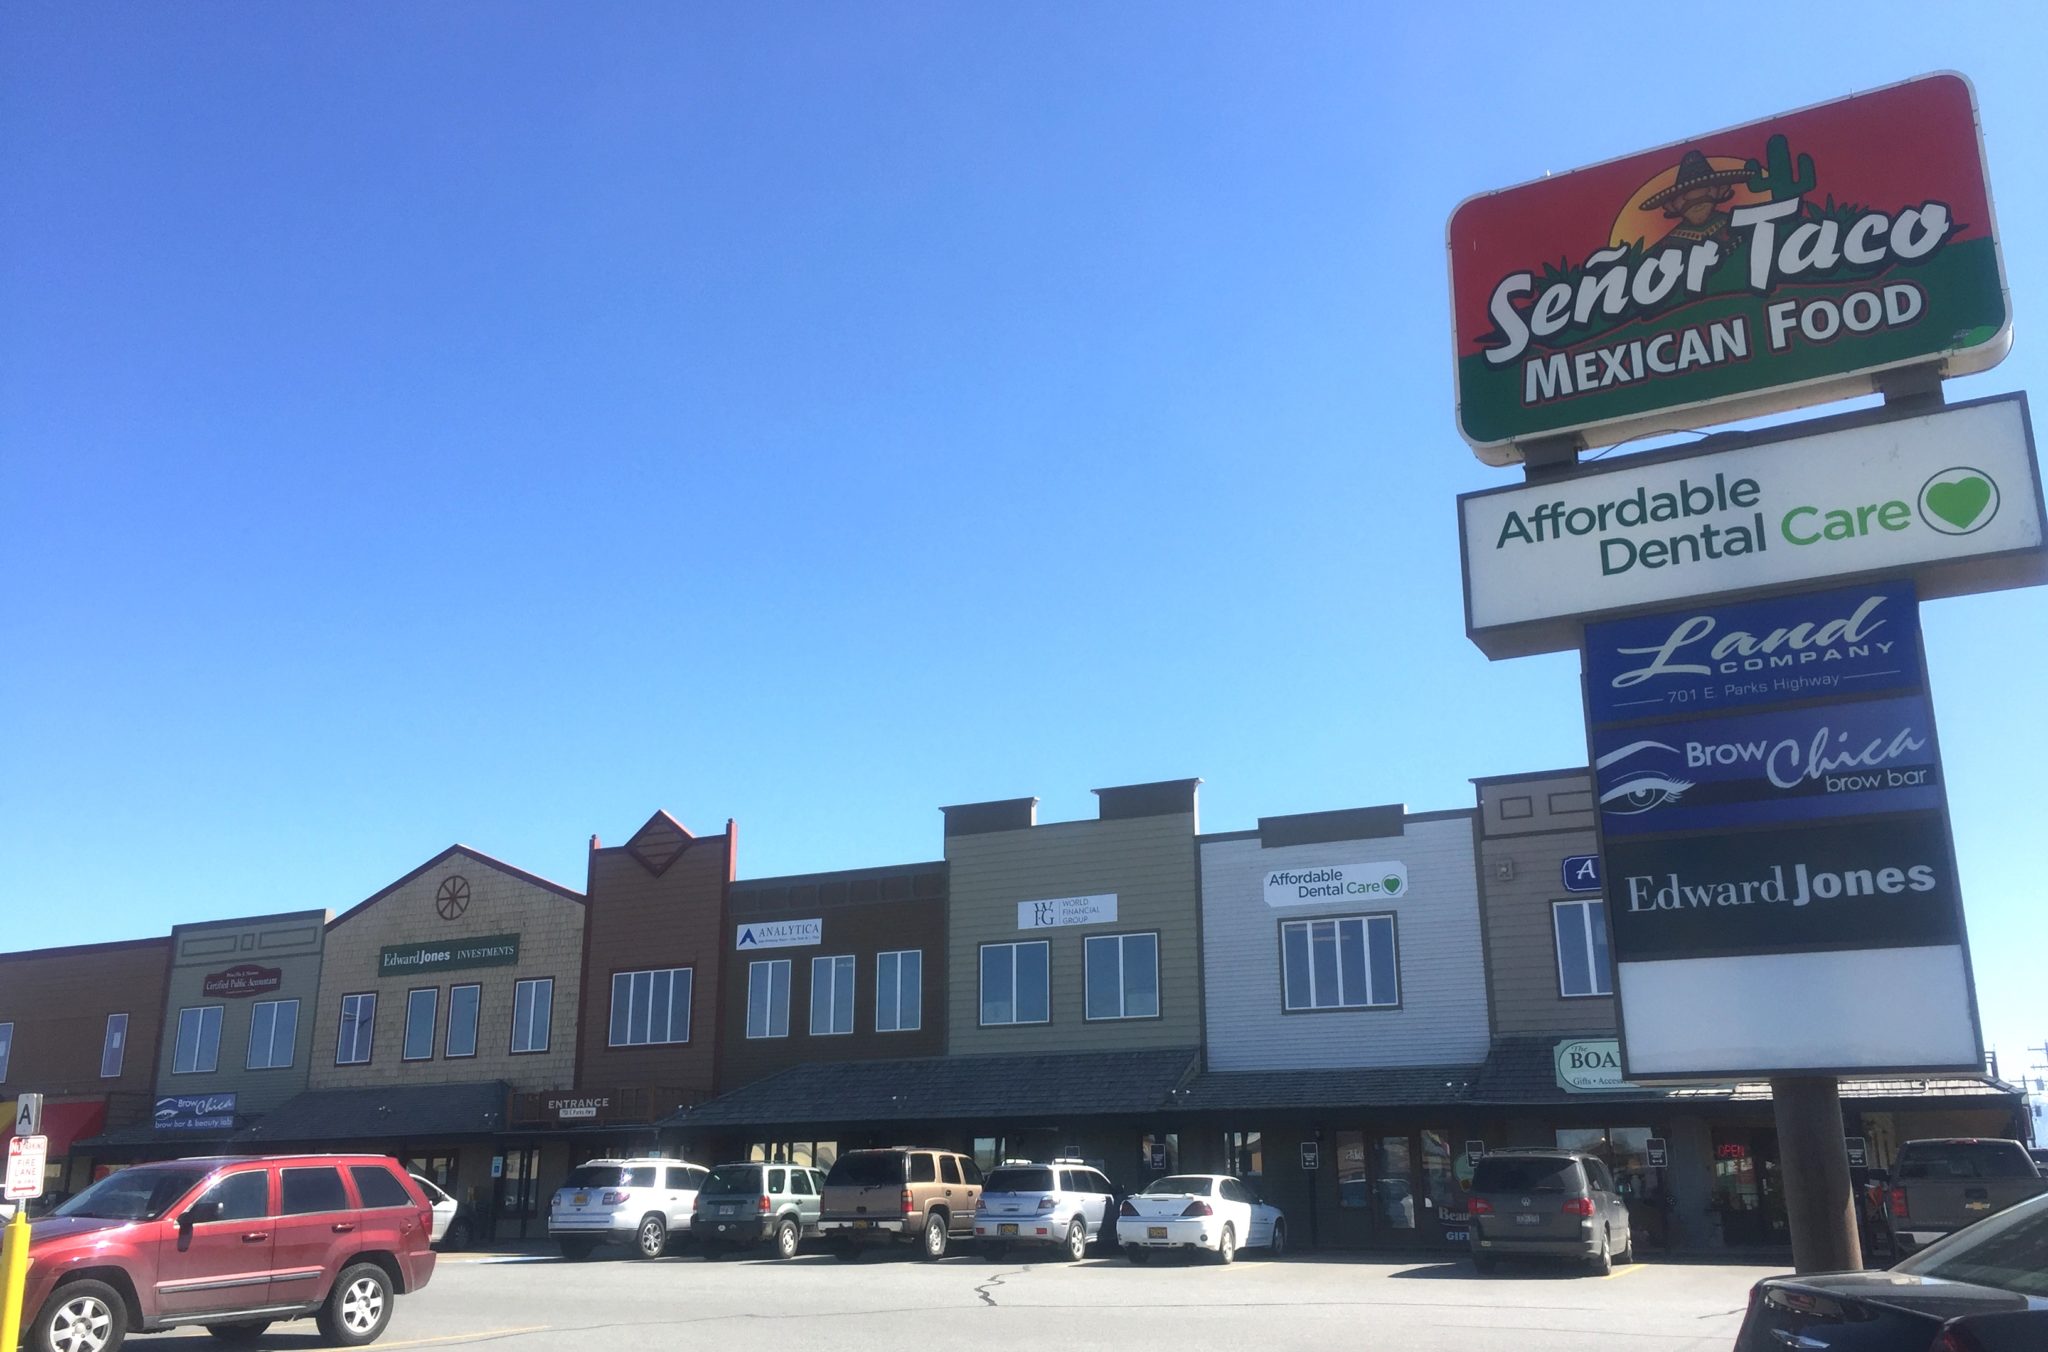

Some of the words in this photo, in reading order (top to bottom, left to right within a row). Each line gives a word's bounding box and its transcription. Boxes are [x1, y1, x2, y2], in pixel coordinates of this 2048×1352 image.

[1485, 238, 1719, 364] Señor
[1730, 197, 1949, 290] Taco
[1524, 318, 1748, 403] MEXICAN
[1768, 284, 1923, 350] FOOD
[1496, 472, 1761, 549] Affordable
[1600, 513, 1767, 577] Dental
[1781, 499, 1912, 546] Care
[1611, 596, 1888, 689] Land
[1720, 640, 1895, 675] COMPANY
[1668, 688, 1697, 704] 701
[1724, 680, 1768, 697] Parks
[1774, 673, 1840, 693] Highway
[1686, 739, 1769, 768] Brow
[1766, 726, 1926, 789] Chica
[1826, 774, 1881, 793] brow
[1887, 768, 1928, 787] bar
[1269, 868, 1343, 887] Affordable
[1298, 883, 1344, 898] Dental
[1346, 881, 1381, 895] Care
[1062, 898, 1089, 907] WORLD
[1062, 906, 1100, 916] FINANCIAL
[1062, 915, 1089, 925] GROUP
[758, 923, 819, 938] ANALYTICA
[457, 945, 514, 960] INVESTMENTS
[1570, 1051, 1621, 1069] BOA
[1573, 1076, 1592, 1086] Gifts
[177, 1099, 198, 1108] Brow
[195, 1097, 233, 1116] Chica
[548, 1097, 609, 1109] ENTRANCE
[18, 1104, 31, 1125] A
[1718, 1144, 1745, 1157] OPEN
[15, 1167, 37, 1177] LANE
[17, 1158, 36, 1168] FIRE
